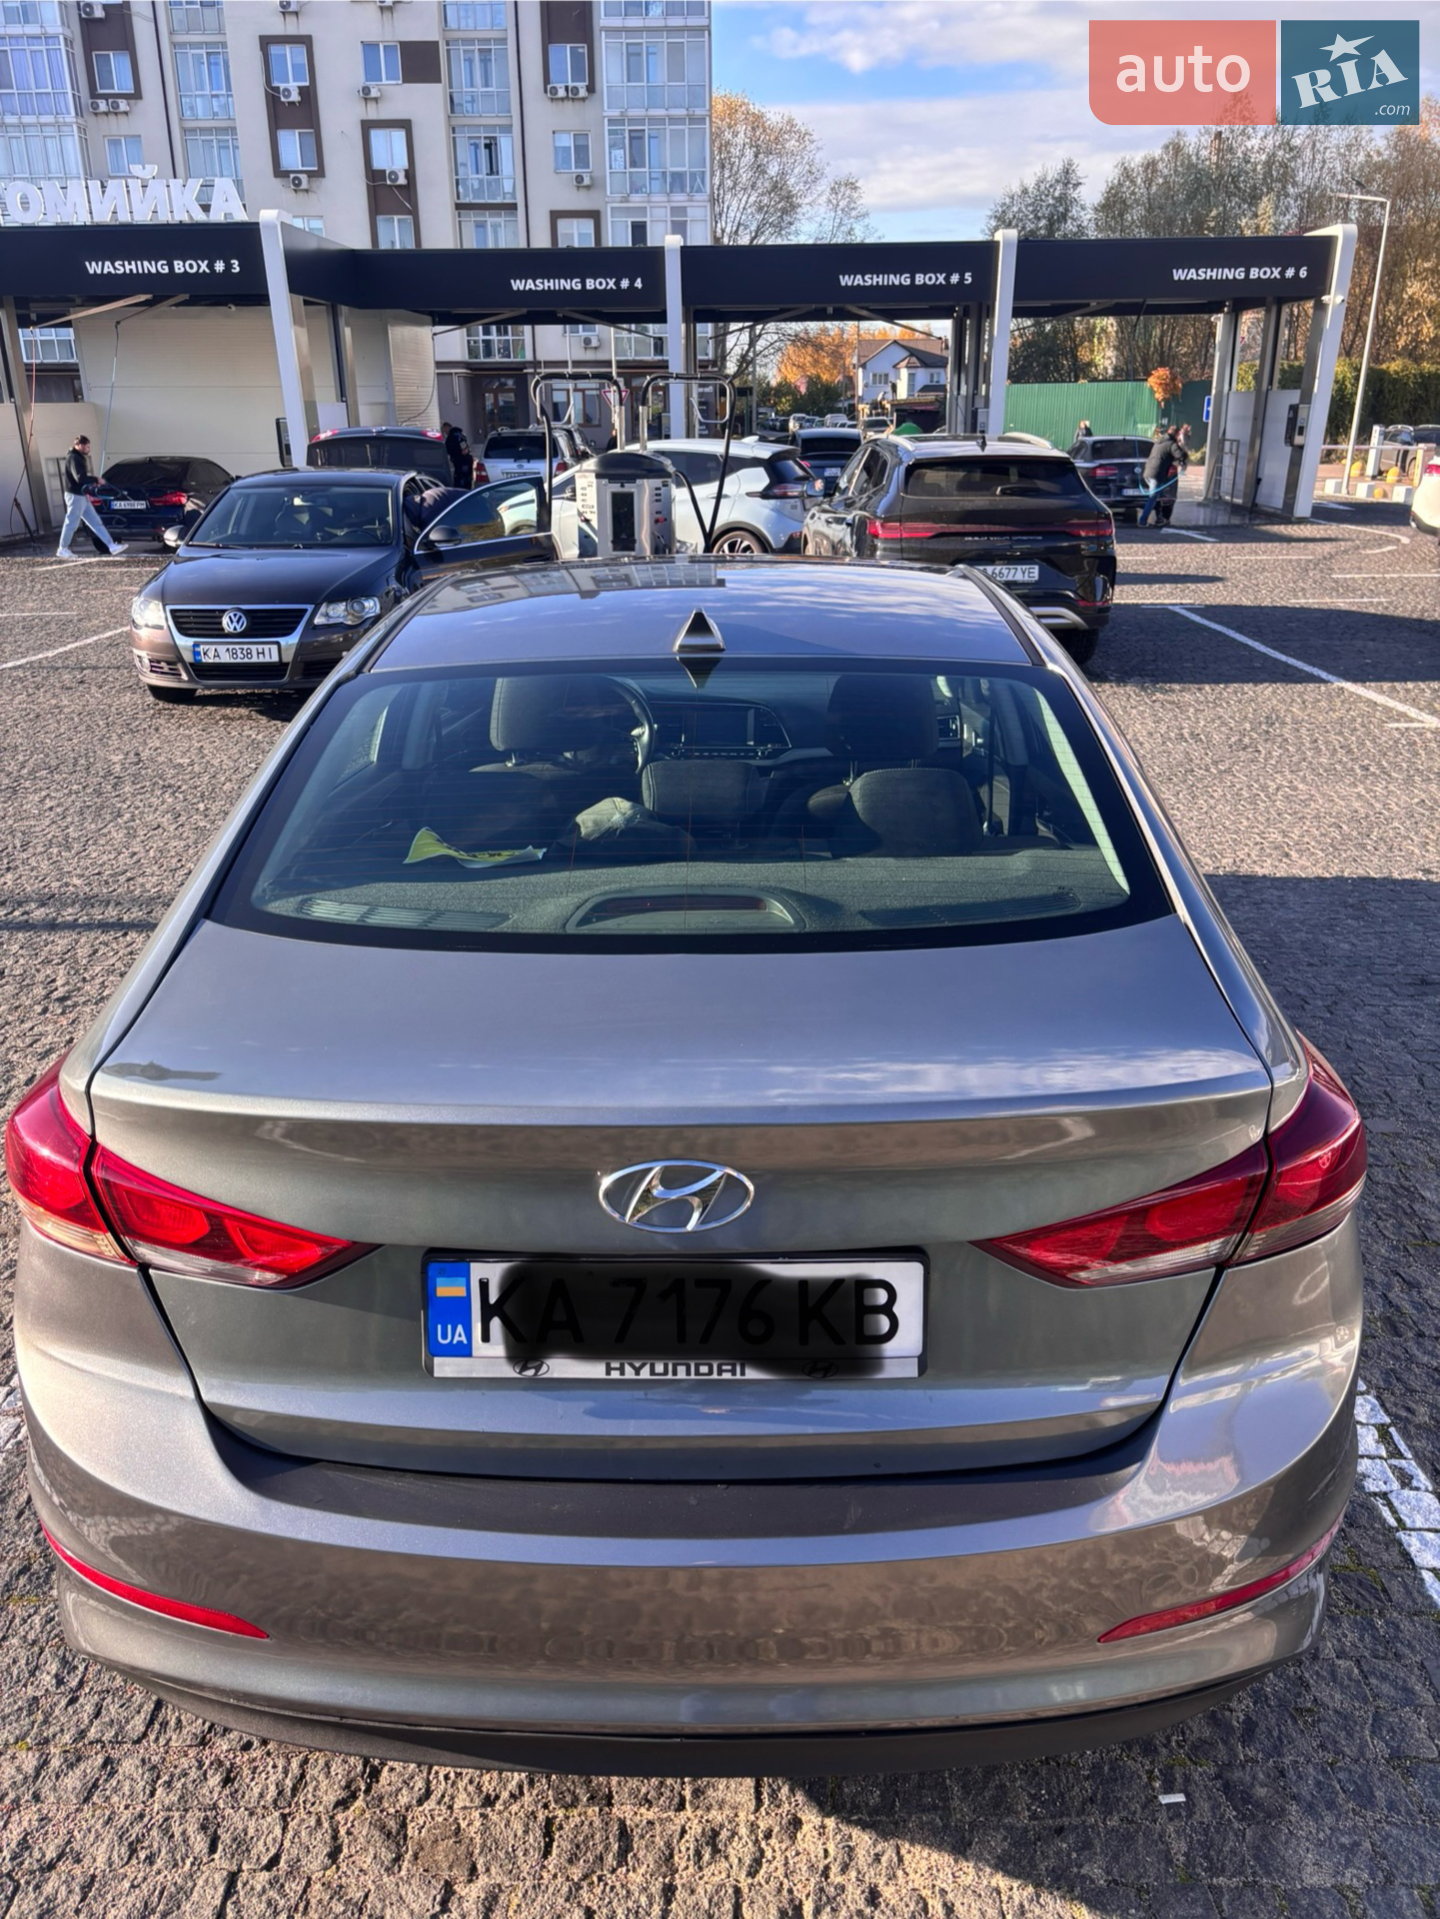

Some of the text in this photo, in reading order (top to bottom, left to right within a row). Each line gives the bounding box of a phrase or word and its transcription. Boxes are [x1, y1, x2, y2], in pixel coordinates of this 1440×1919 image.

[0, 164, 250, 227] ОМИЙКА
[85, 259, 240, 275] WASHING BOX # 3
[1172, 266, 1308, 281] WASHING BOX # 6
[510, 278, 643, 292] WASHING BOX # 4
[838, 273, 973, 287] WASHING BOX # 5
[991, 567, 1019, 579] 6677
[1020, 567, 1036, 579] YE
[202, 647, 221, 661] KA
[225, 647, 253, 661] 1838
[479, 1277, 585, 1344] KA
[798, 1278, 899, 1346] KB
[437, 1324, 468, 1345] UA
[604, 1361, 747, 1377] HYUNDAI
